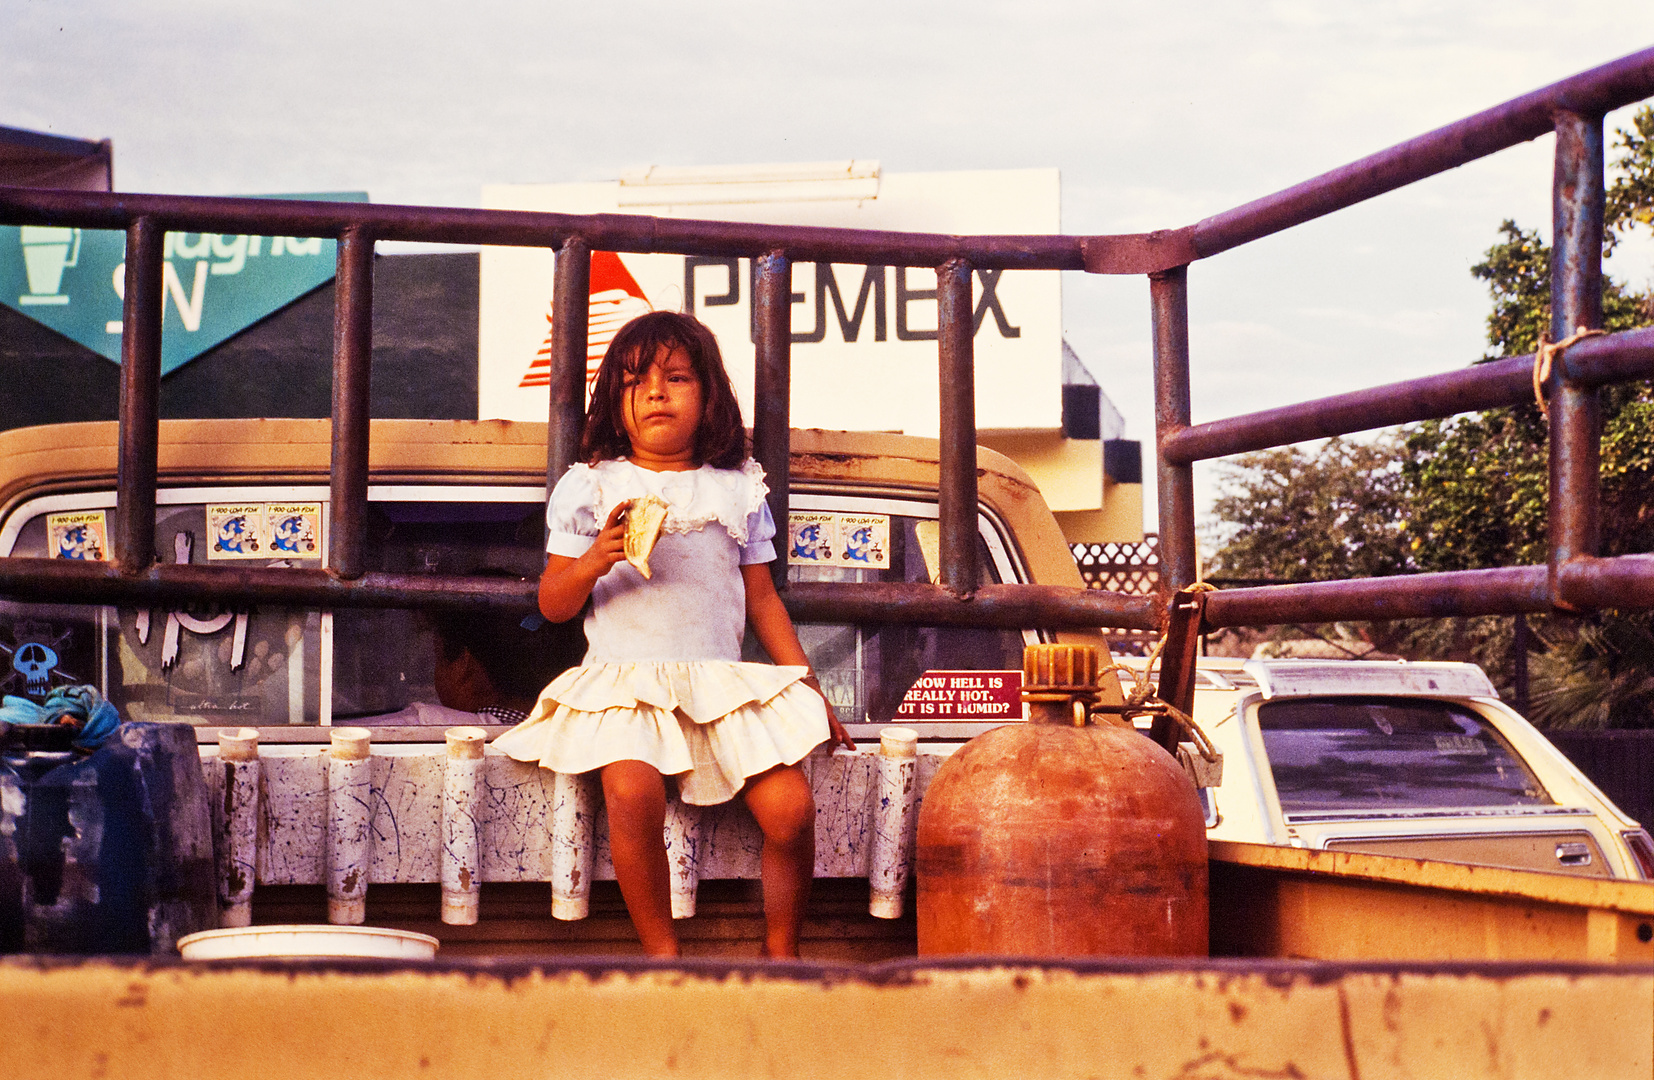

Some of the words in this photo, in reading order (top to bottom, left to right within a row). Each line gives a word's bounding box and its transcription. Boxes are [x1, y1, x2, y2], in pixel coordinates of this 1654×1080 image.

[911, 677, 946, 689] NOW
[950, 677, 985, 689] HELL
[988, 677, 1003, 689] IS
[903, 690, 956, 701] REALLY
[960, 690, 994, 701] HOT,
[897, 703, 916, 714] UT
[920, 703, 935, 714] IS
[938, 703, 953, 714] IT
[957, 702, 1010, 714] HUMID?
